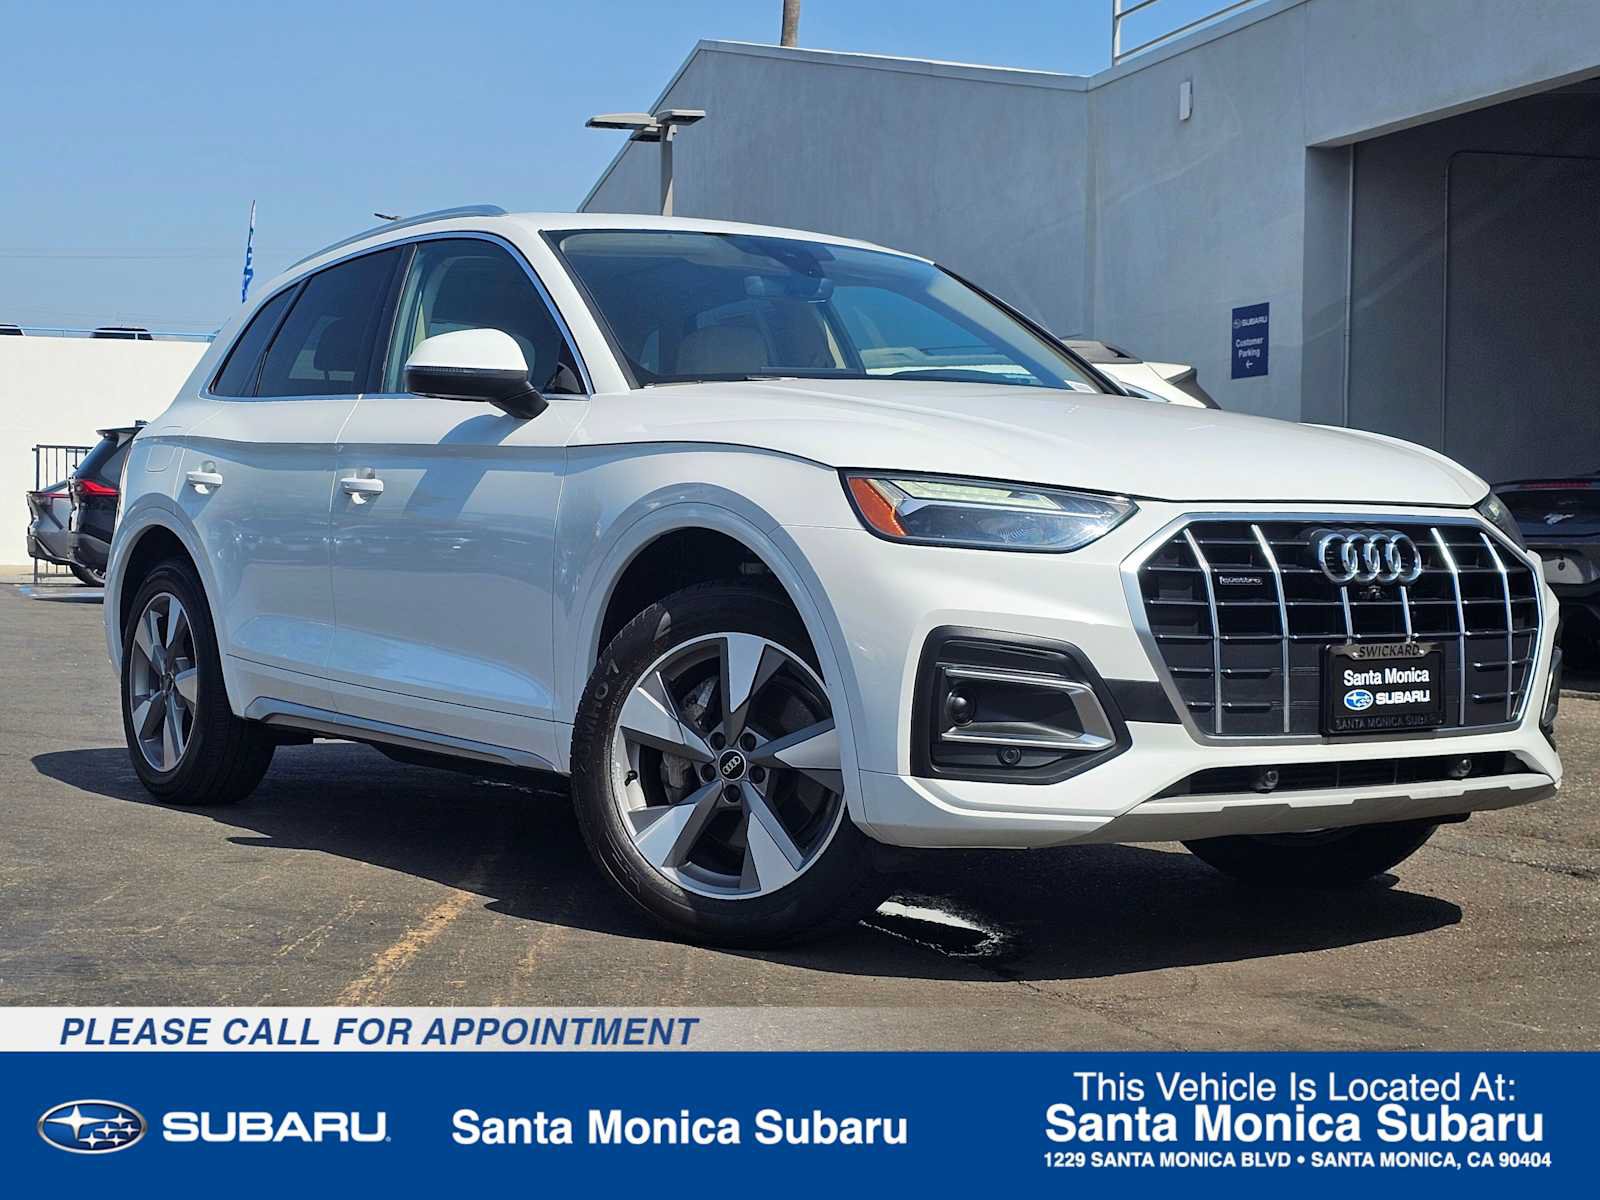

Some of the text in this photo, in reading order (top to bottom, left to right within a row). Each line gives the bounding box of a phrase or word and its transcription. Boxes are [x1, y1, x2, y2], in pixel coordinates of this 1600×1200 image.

[1241, 316, 1268, 327] SUBARU
[1236, 337, 1263, 348] Customer
[1239, 349, 1260, 359] Parking
[1359, 644, 1420, 657] SWICKARD
[1344, 667, 1429, 686] Santa Monica
[1376, 690, 1430, 705] SUBARU
[1336, 716, 1365, 730] SANTA
